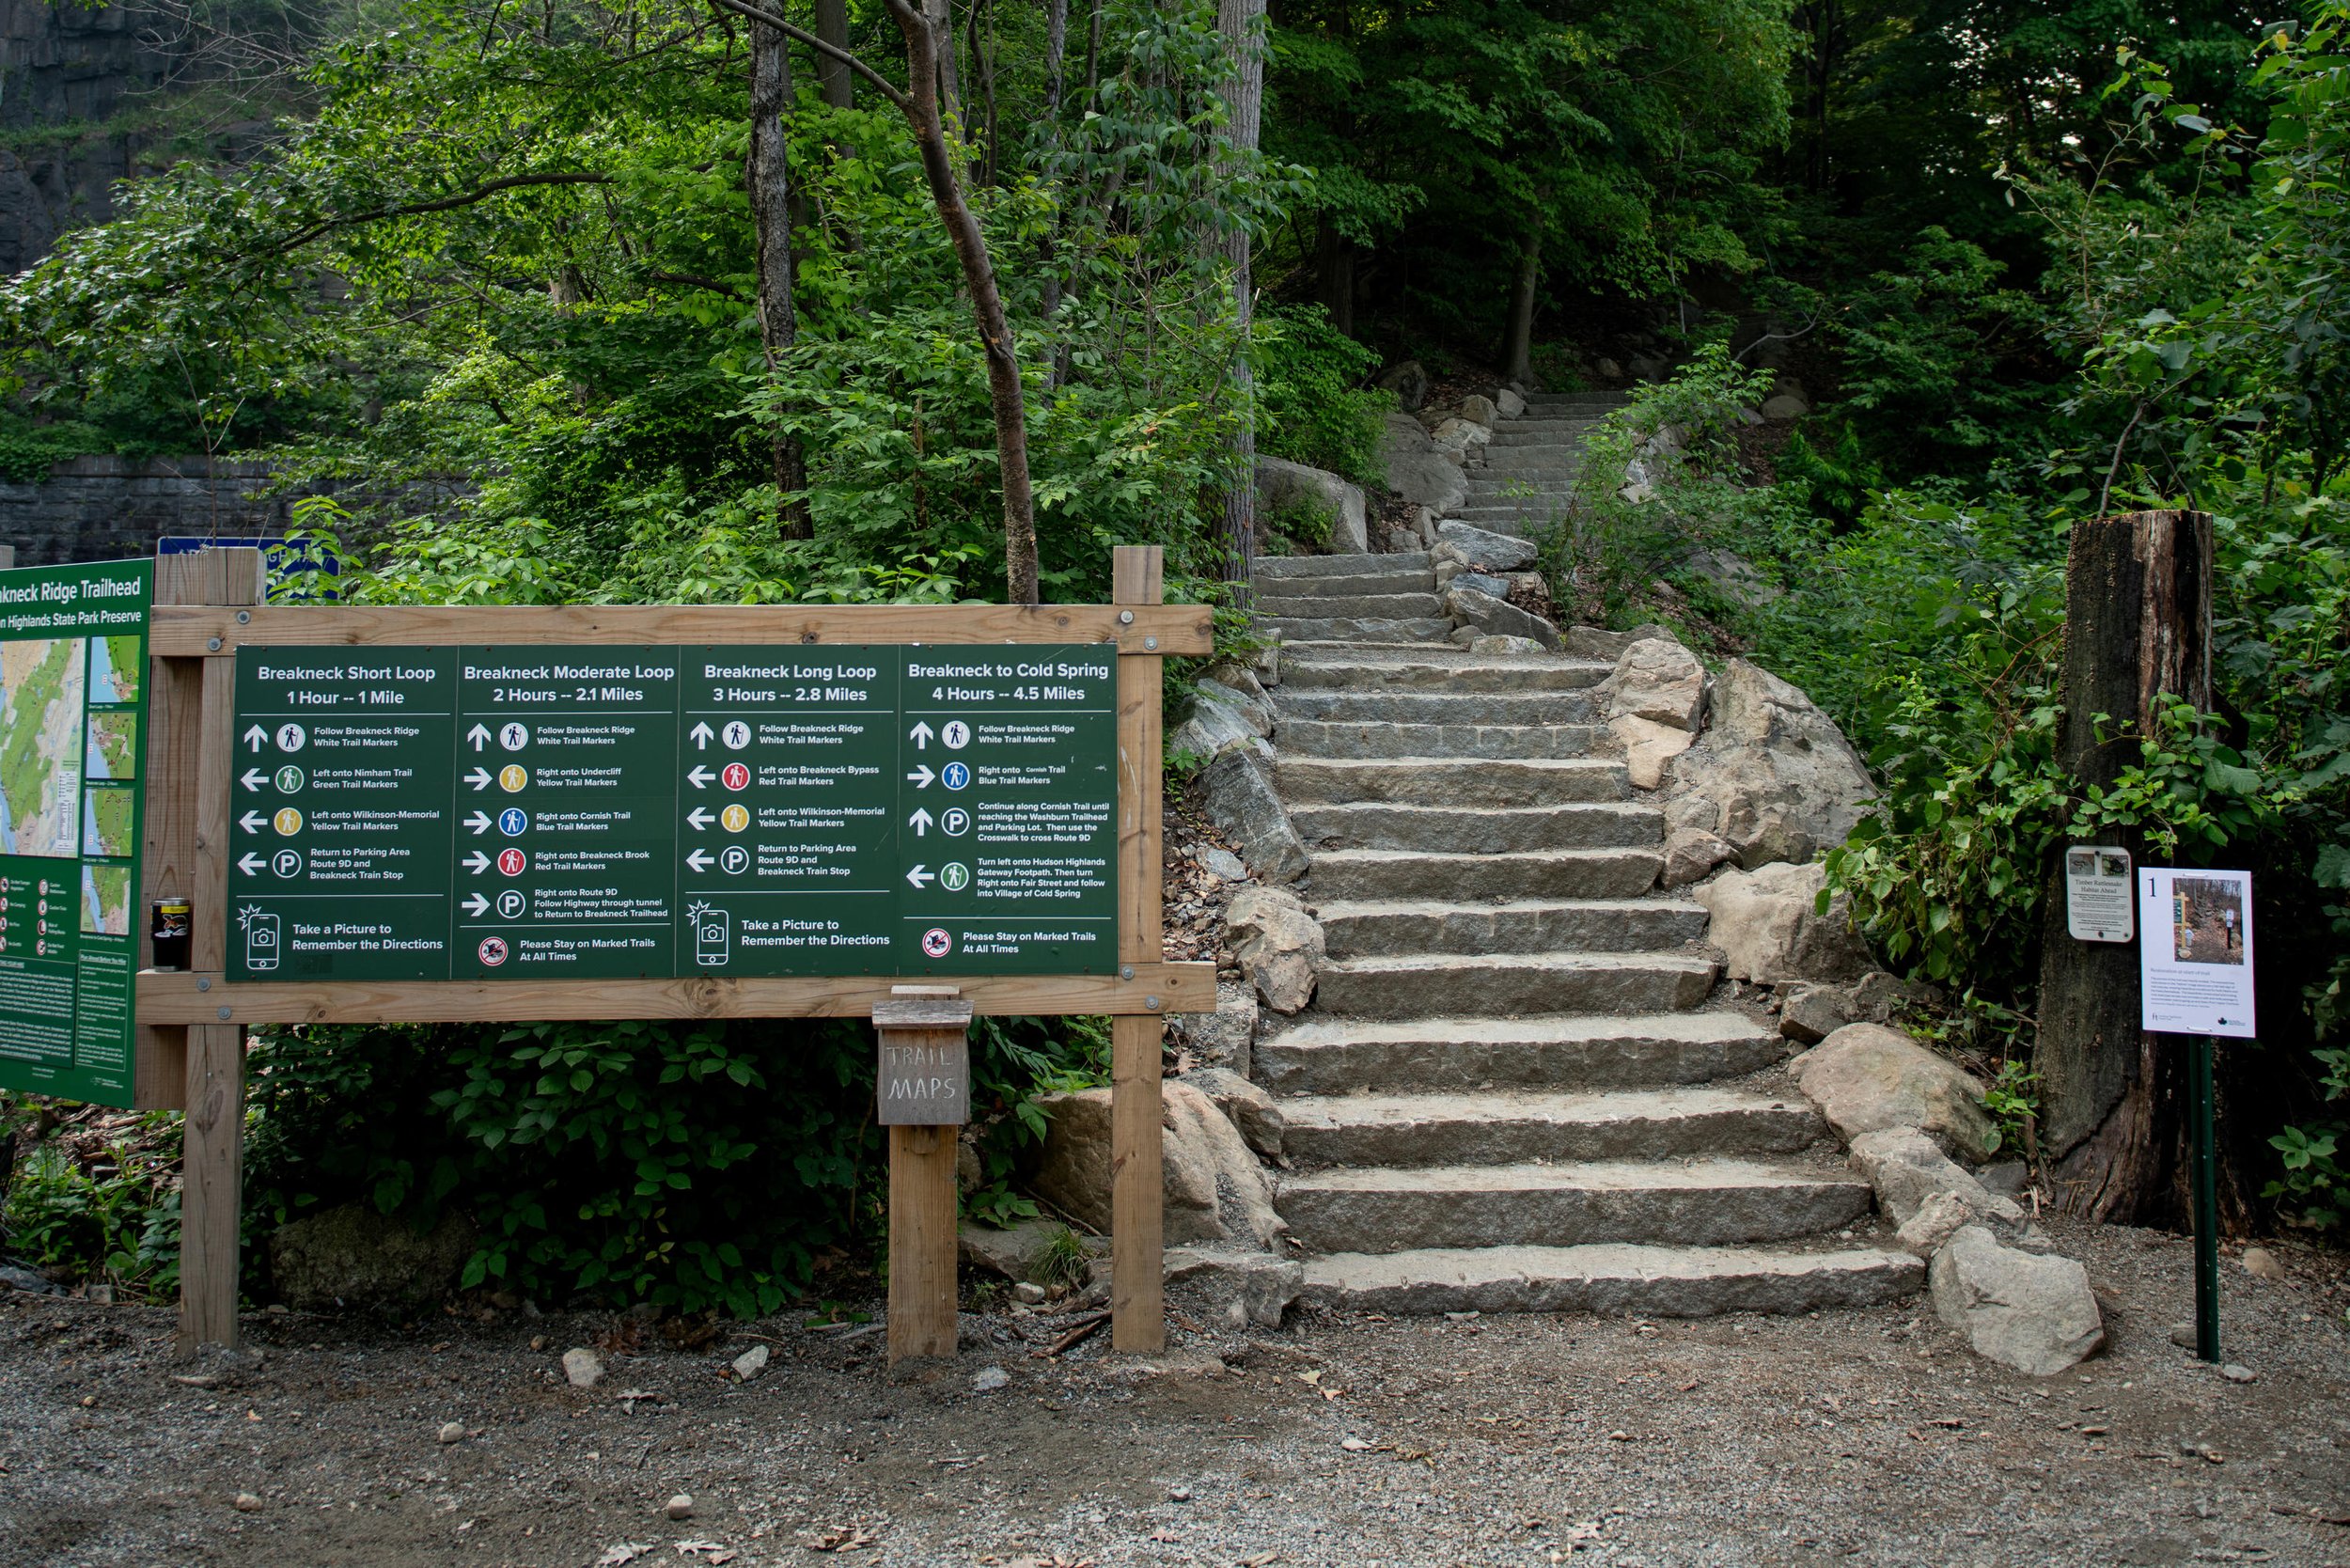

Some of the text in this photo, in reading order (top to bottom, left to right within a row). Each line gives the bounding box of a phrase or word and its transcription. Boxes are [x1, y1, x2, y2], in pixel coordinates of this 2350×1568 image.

[40, 581, 78, 604] Ridge
[80, 575, 141, 599] Trailhead
[8, 613, 51, 631] Highlands
[53, 612, 76, 626] State
[78, 611, 99, 624] Park
[101, 610, 142, 623] Preserve
[258, 666, 435, 682] Breakneck Short Loop
[464, 666, 674, 681] Breakneck Moderate Loop
[705, 665, 876, 681] Breakneck Long Loop
[909, 663, 1108, 680] Breakneck to Cold Spring
[288, 691, 294, 704] 1
[299, 691, 339, 704] Hour
[358, 691, 365, 704] 1
[370, 690, 404, 704] Mile
[493, 688, 504, 701] 2
[509, 688, 556, 701] Hours
[576, 688, 596, 701] 2.1
[602, 687, 643, 700] Miles
[713, 688, 724, 701] 3
[728, 688, 776, 701] Hours
[795, 688, 821, 701] 2.8
[825, 687, 867, 701] Miles
[932, 687, 944, 700] 4
[948, 687, 995, 700] Hours
[1013, 686, 1040, 699] 4.5
[1043, 686, 1085, 699] Miles
[394, 727, 419, 736] Ridge
[393, 768, 412, 776] Trail
[536, 768, 558, 777] Right
[581, 767, 621, 776] Undercliff
[848, 765, 880, 775] Bypass
[979, 766, 1000, 776] Right
[312, 780, 339, 789] Green
[1016, 803, 1039, 812] along
[353, 810, 440, 819] Wilkinson-Memorial
[536, 812, 558, 822] Right
[978, 813, 1013, 822] reaching
[310, 848, 340, 856] Return
[353, 848, 387, 857] Parking
[535, 852, 557, 860] Right
[338, 859, 352, 868] 9D
[353, 859, 370, 868] and
[1066, 858, 1105, 867] Highlands
[359, 870, 381, 879] Train
[383, 870, 403, 880] Stop
[2147, 877, 2156, 897] 1
[535, 889, 556, 898] Right
[995, 889, 1023, 899] Village
[1055, 889, 1081, 899] Spring
[564, 900, 600, 908] Highway
[602, 899, 634, 908] through
[630, 909, 667, 917] Trailhead
[292, 923, 391, 934] Take a Picture to
[996, 933, 1017, 942] Stay
[292, 938, 443, 949] Remember the Directions
[521, 940, 552, 949] Please
[554, 940, 575, 949] Stay
[592, 939, 628, 948] Marked
[630, 938, 655, 948] Trails
[963, 945, 1019, 953] At All Times
[532, 952, 545, 961] All
[547, 952, 577, 961] Times
[886, 1046, 954, 1066] TRAIL
[887, 1076, 956, 1100] MAPS
